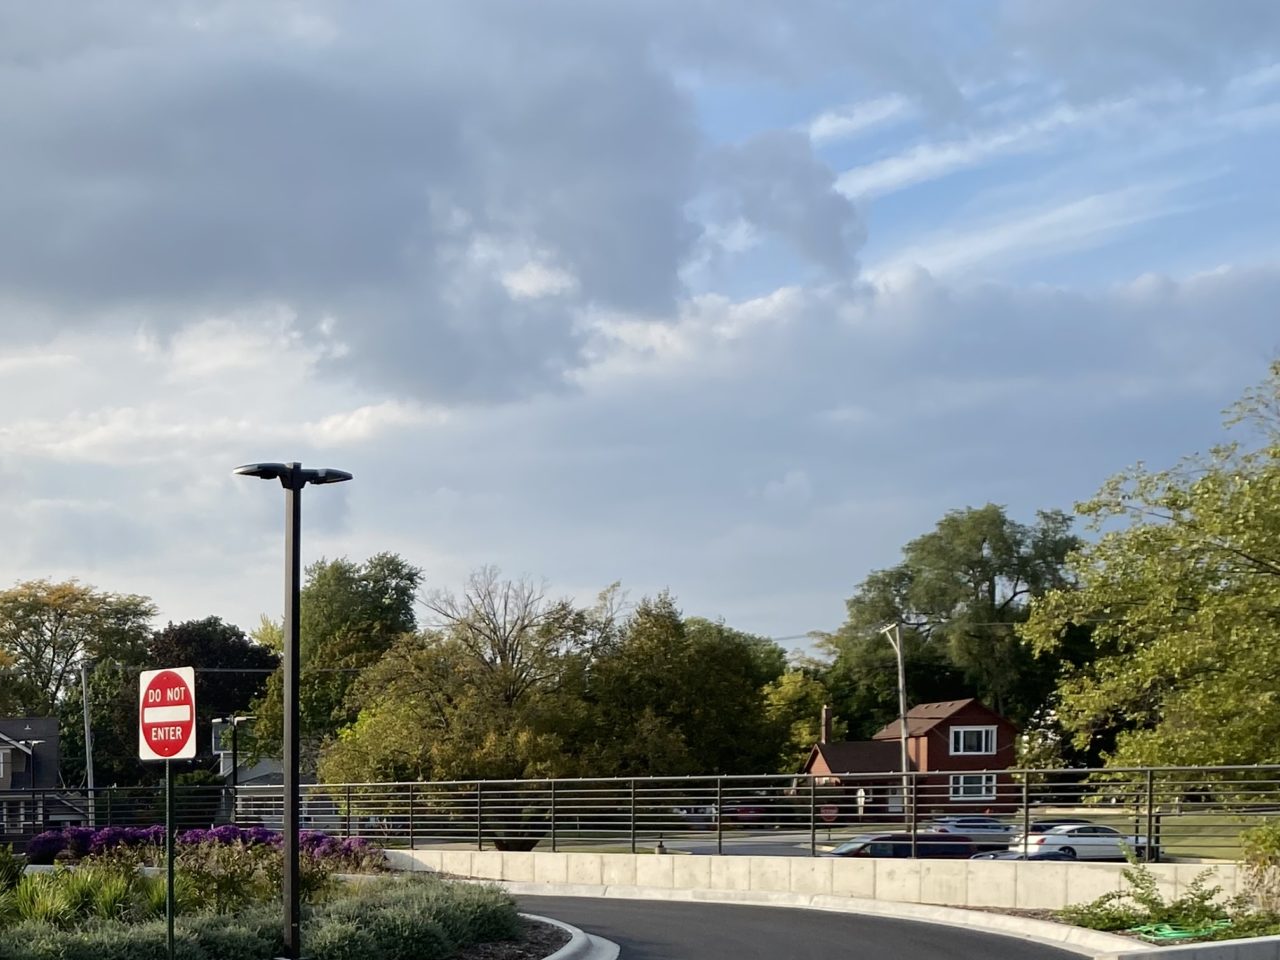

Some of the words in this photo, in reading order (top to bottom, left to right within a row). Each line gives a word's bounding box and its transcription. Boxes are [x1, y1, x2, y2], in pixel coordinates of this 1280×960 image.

[148, 689, 162, 703] DO
[166, 687, 186, 701] NOT
[151, 726, 182, 741] ENTER
